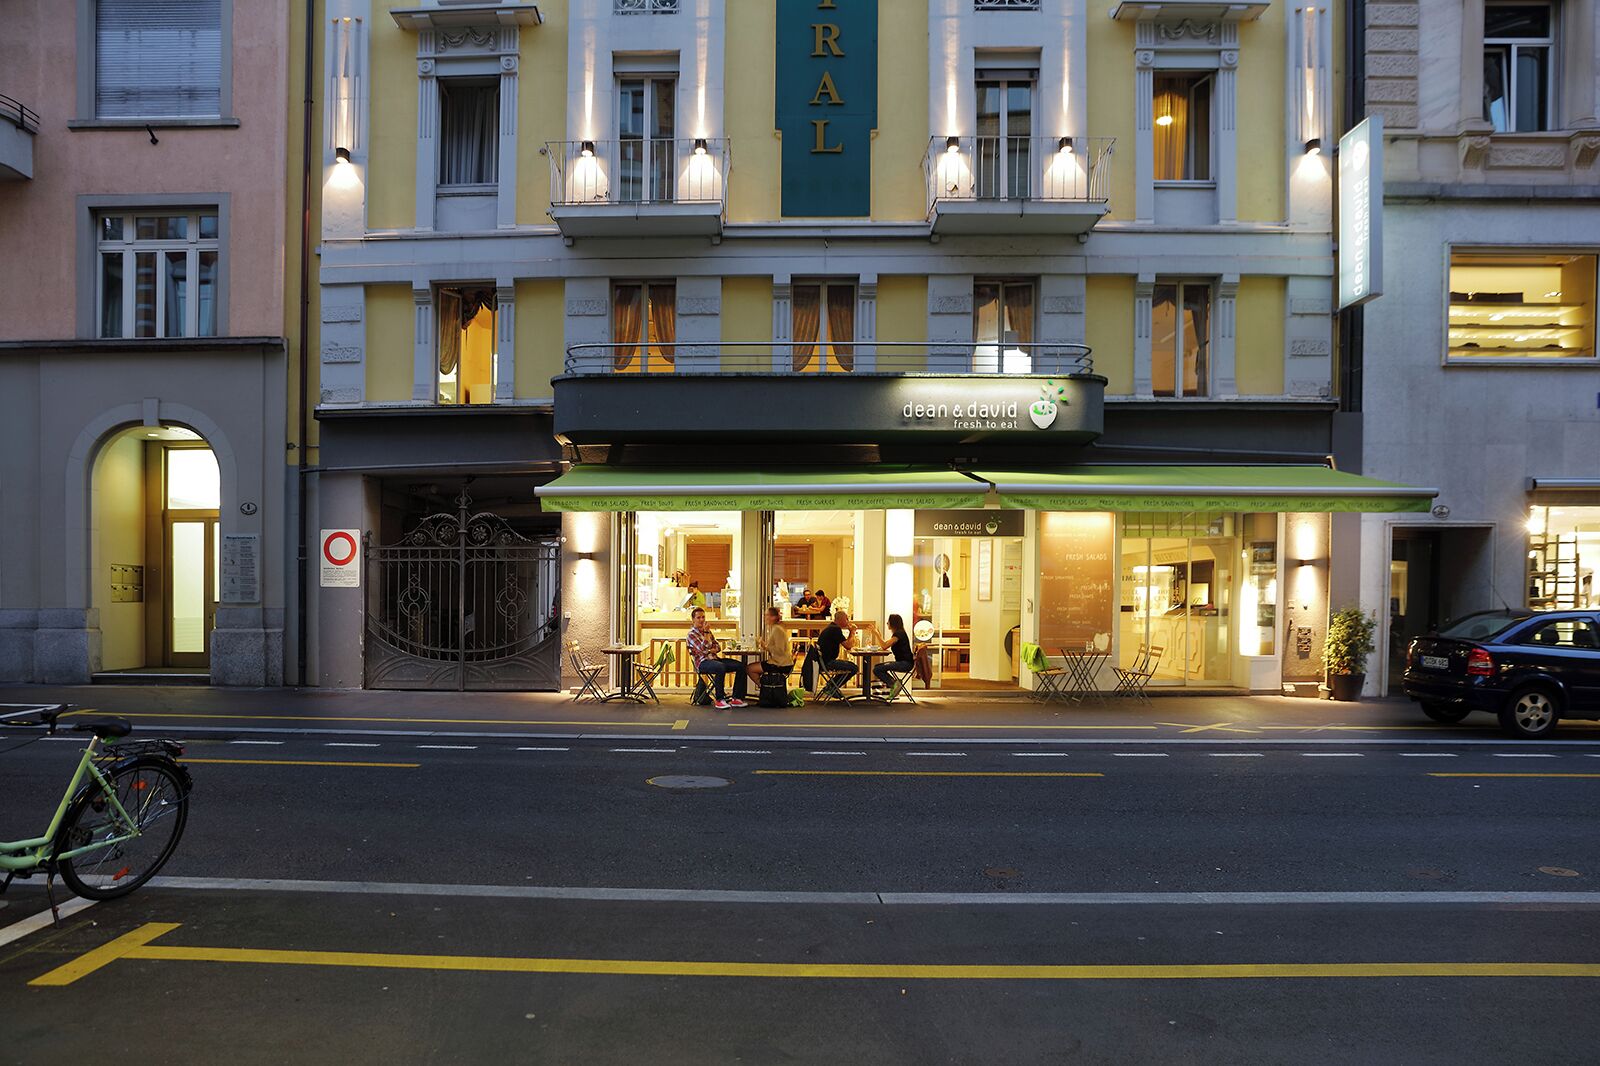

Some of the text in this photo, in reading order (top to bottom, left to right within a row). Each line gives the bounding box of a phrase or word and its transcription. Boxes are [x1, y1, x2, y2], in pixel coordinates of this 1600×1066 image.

[809, 0, 845, 154] RAL
[903, 401, 1017, 418] dean & david
[954, 420, 1018, 429] fresh to eat
[685, 499, 701, 507] FRESH
[934, 522, 953, 531] dean
[960, 522, 982, 531] david
[1065, 553, 1107, 561] FRESH SALADS
